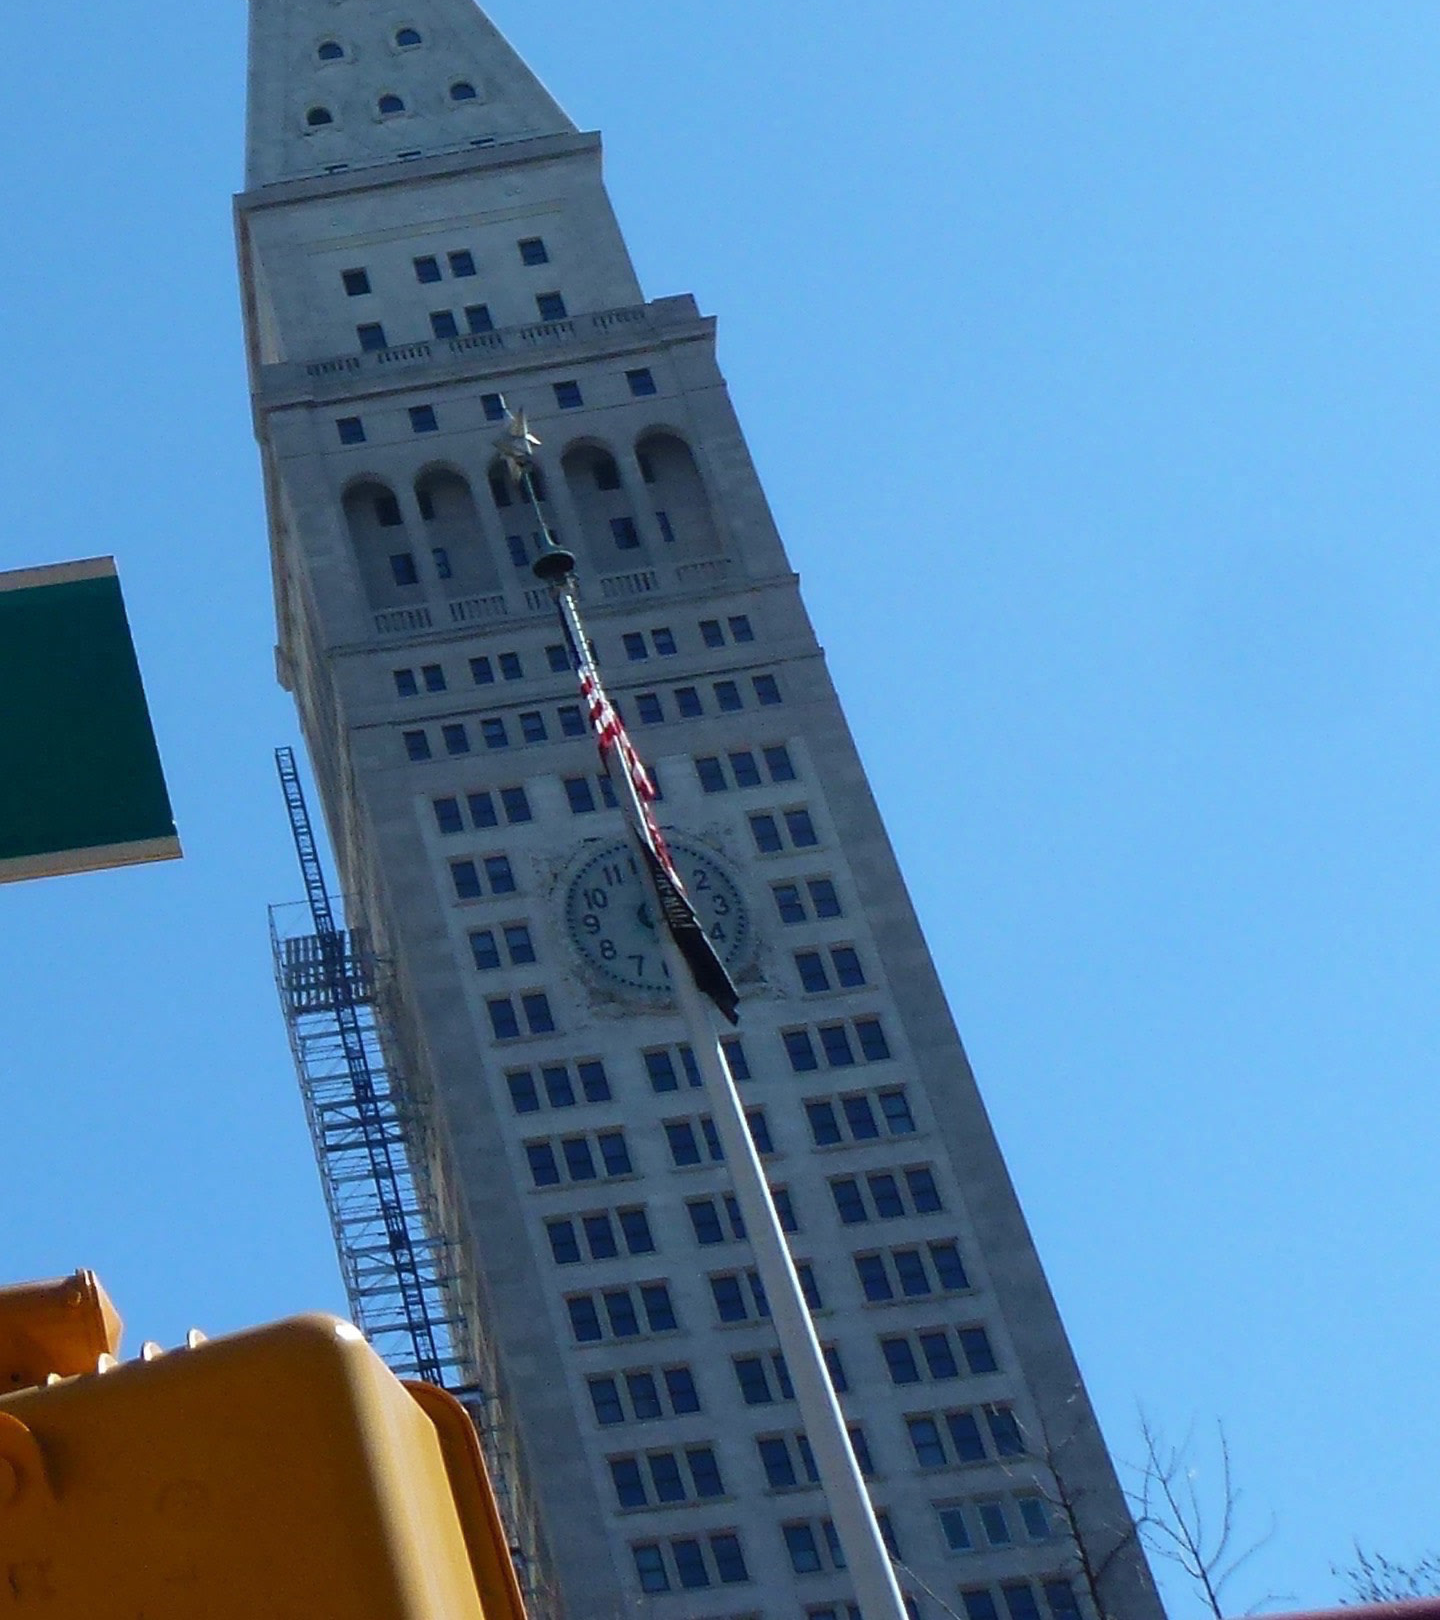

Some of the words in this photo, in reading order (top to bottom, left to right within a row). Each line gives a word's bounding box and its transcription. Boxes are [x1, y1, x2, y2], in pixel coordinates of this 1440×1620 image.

[603, 864, 623, 887] 11
[693, 869, 711, 892] 2
[584, 886, 608, 910] 10
[712, 894, 729, 916] 3
[583, 913, 600, 935] 9
[711, 922, 727, 943] 4
[599, 939, 618, 961] 8
[628, 954, 644, 977] 7
